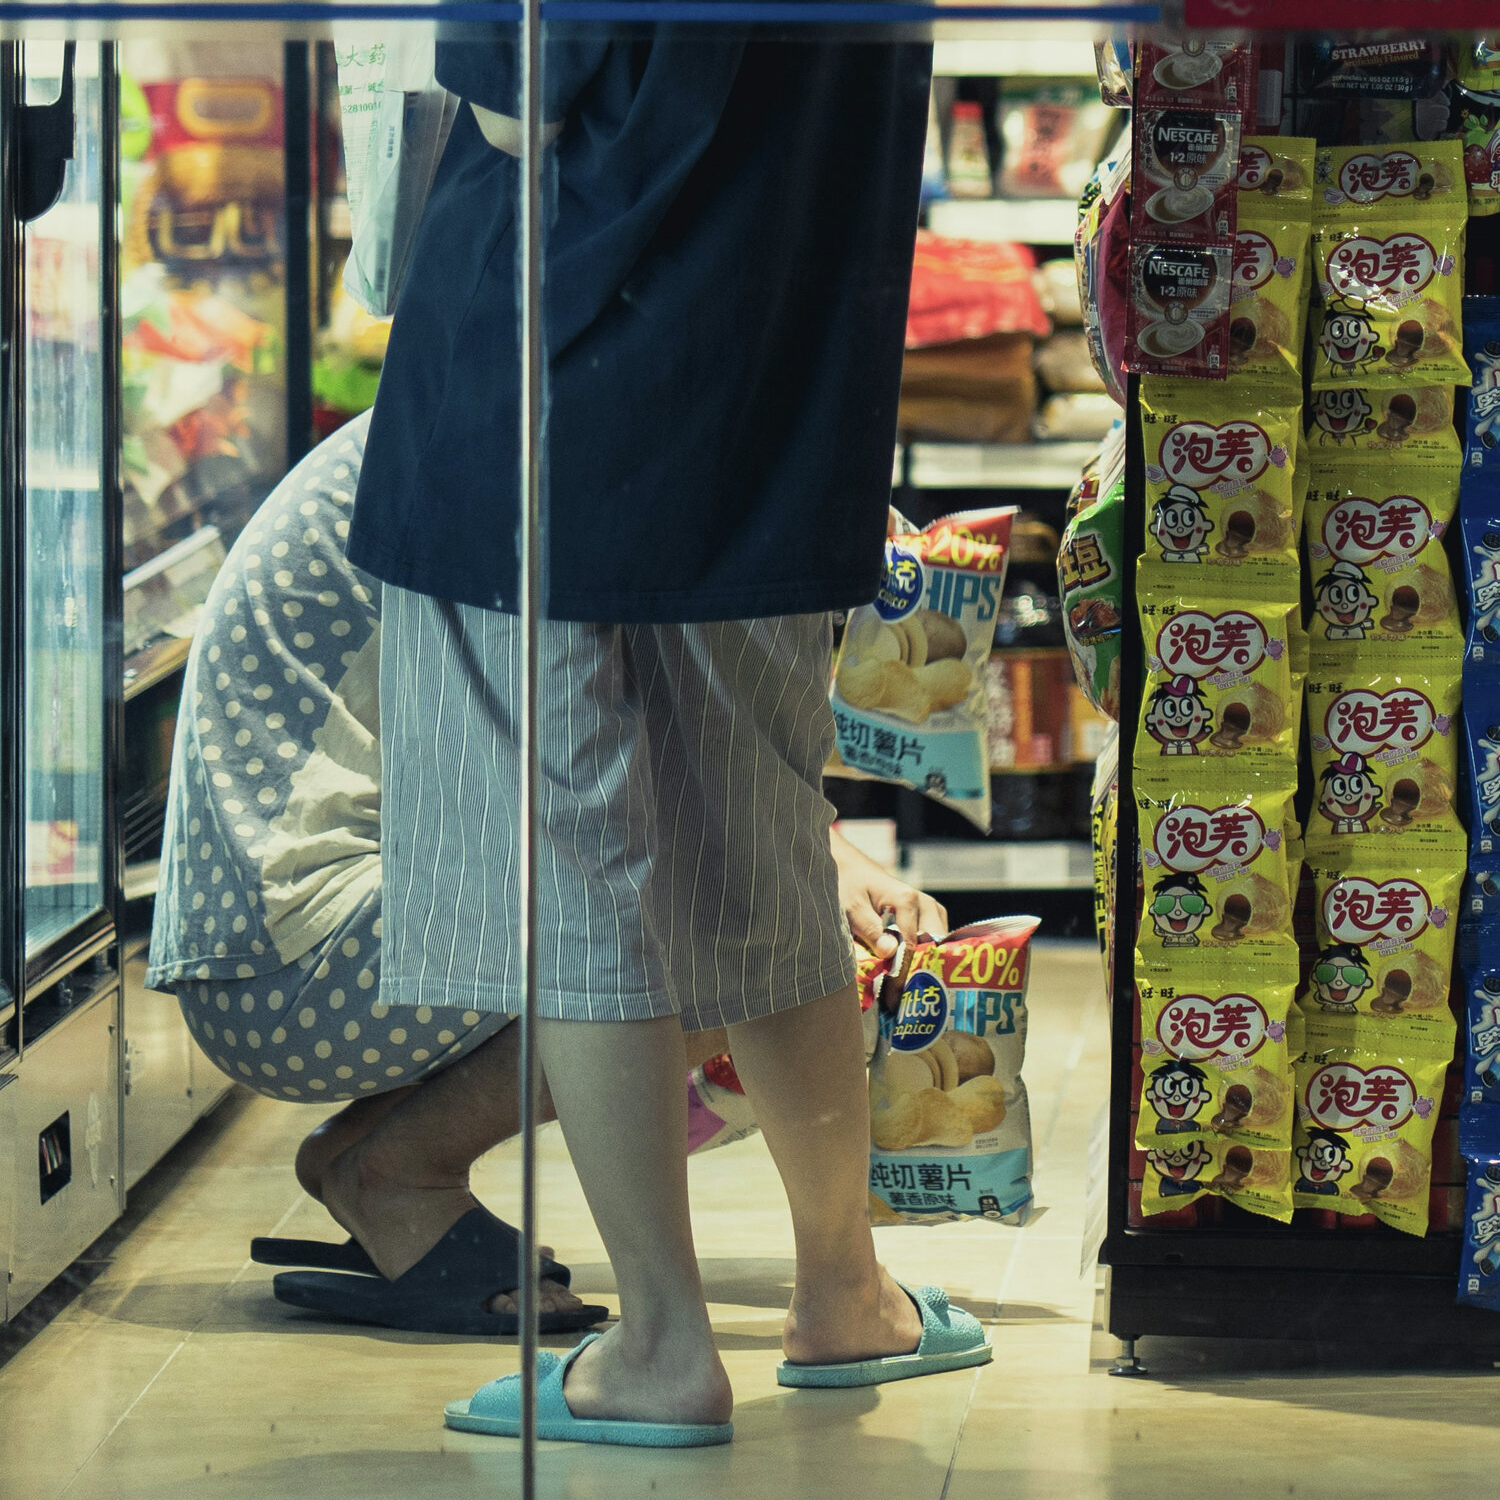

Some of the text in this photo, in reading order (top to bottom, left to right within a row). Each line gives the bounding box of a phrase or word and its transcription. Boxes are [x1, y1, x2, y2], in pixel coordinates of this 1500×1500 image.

[1332, 40, 1426, 61] STRAWBERRY
[1158, 128, 1218, 143] NESCAFE
[1149, 261, 1209, 278] NESCAFE
[1339, 243, 1424, 288] 泡芙
[1172, 428, 1259, 474] 泡芙
[927, 525, 1001, 572] 20%
[1335, 505, 1421, 550] 泡芙
[1170, 620, 1256, 665] 泡芙
[1337, 697, 1424, 743] 泡芙
[1166, 813, 1253, 859] 泡芙
[1333, 887, 1421, 932] 泡芙
[950, 943, 1019, 987] 20%
[949, 990, 1021, 1037] HIPS
[1168, 1003, 1257, 1049] 泡芙
[1317, 1074, 1406, 1120] 泡芙
[871, 1163, 972, 1192] 纯切薯片
[890, 1193, 957, 1209] 薯香原味
